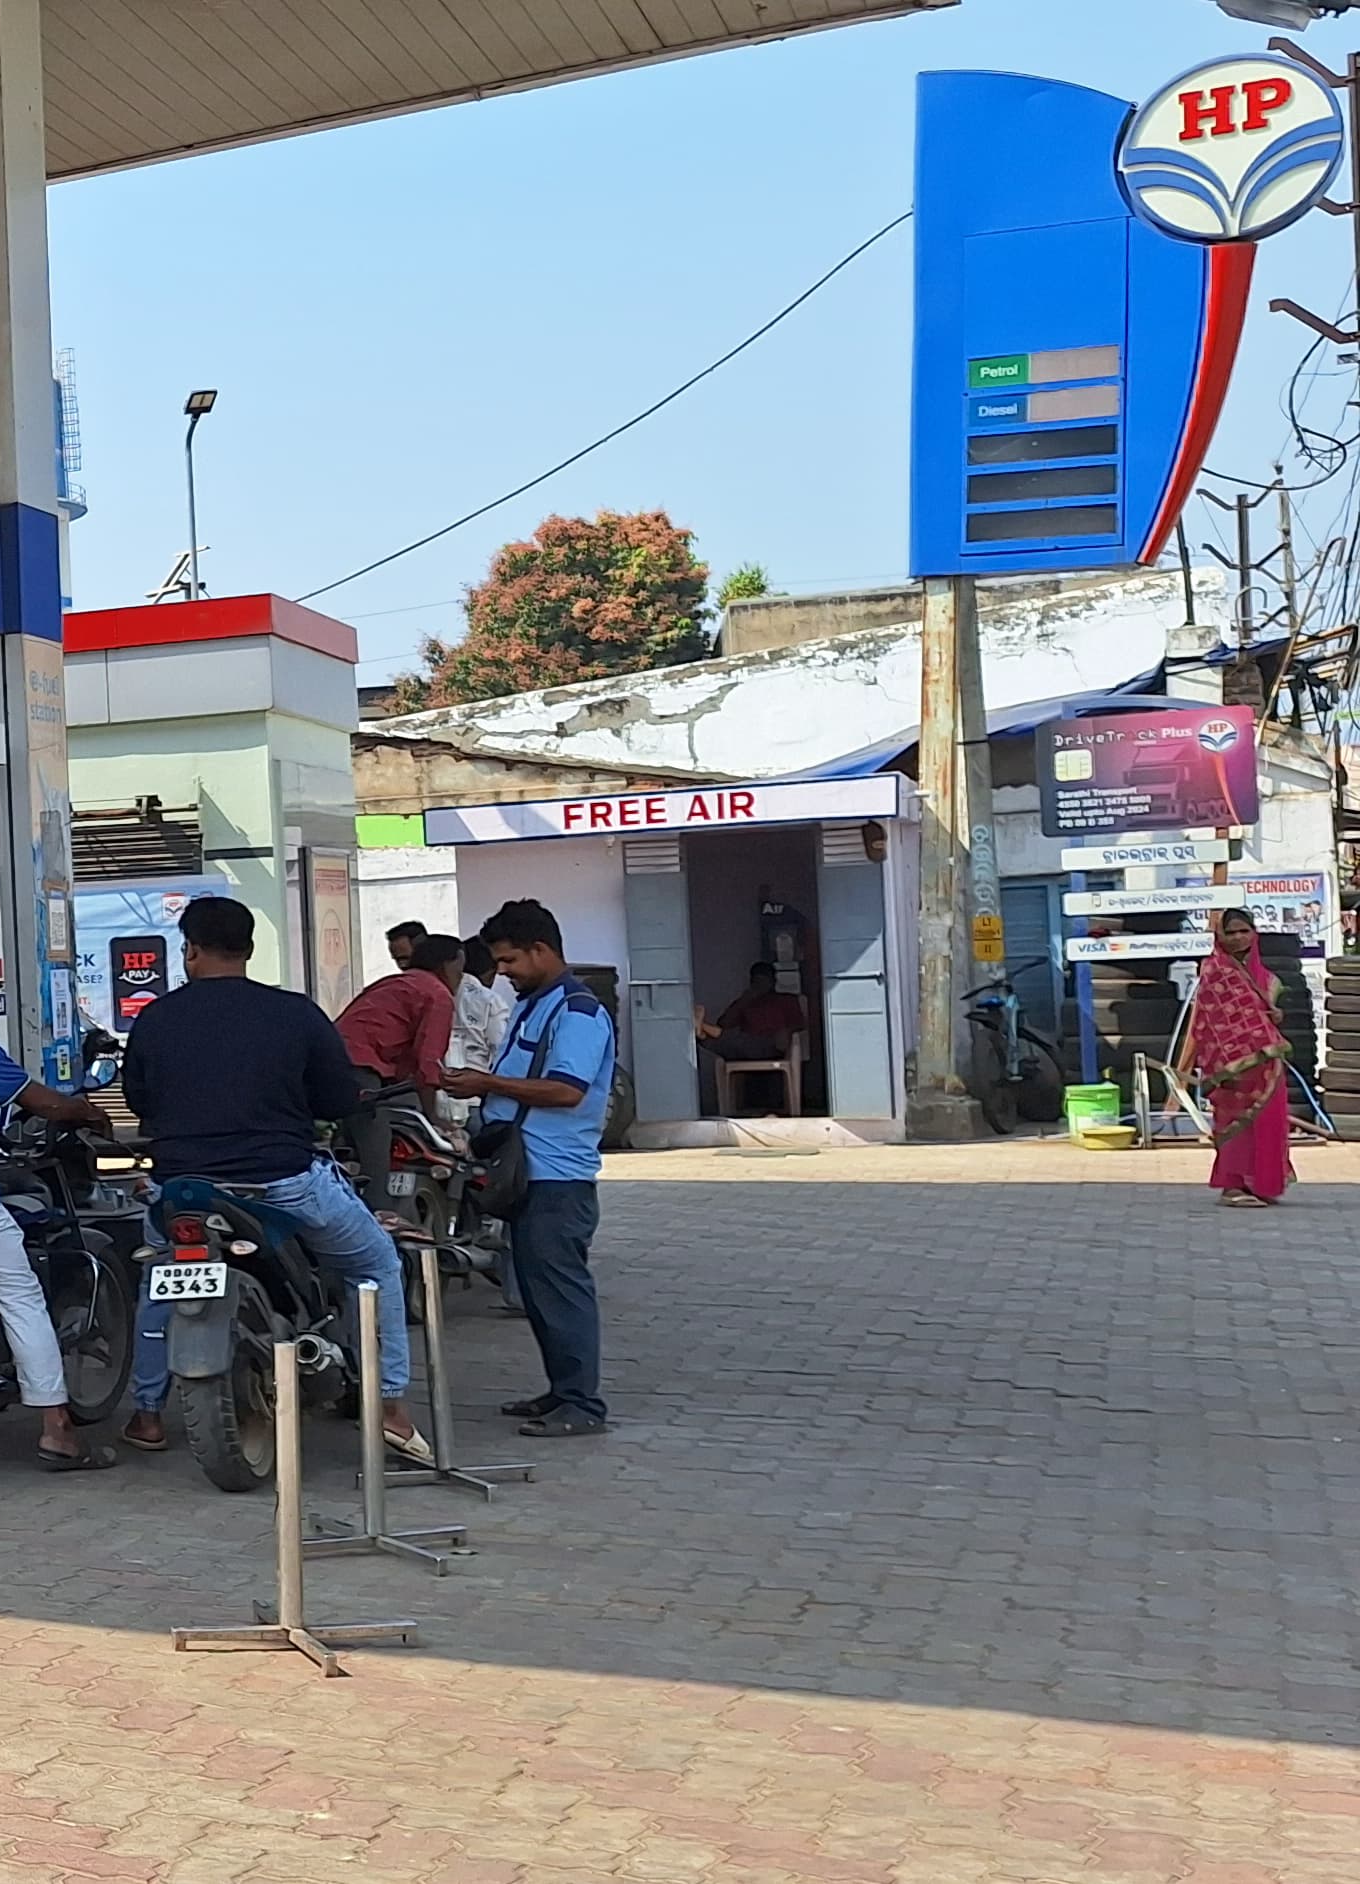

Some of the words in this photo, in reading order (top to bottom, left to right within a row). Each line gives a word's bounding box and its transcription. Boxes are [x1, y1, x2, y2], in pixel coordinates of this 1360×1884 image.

[1179, 78, 1292, 141] HP
[980, 364, 1018, 378] Petrol
[979, 402, 1017, 417] Diesel
[1162, 727, 1193, 739] Plus
[1208, 723, 1228, 733] HP
[563, 797, 667, 830] FREE
[686, 791, 755, 821] AIR
[1078, 943, 1108, 953] VISA
[123, 952, 157, 969] HP
[128, 970, 150, 980] PAY
[156, 1279, 218, 1295] 6343
